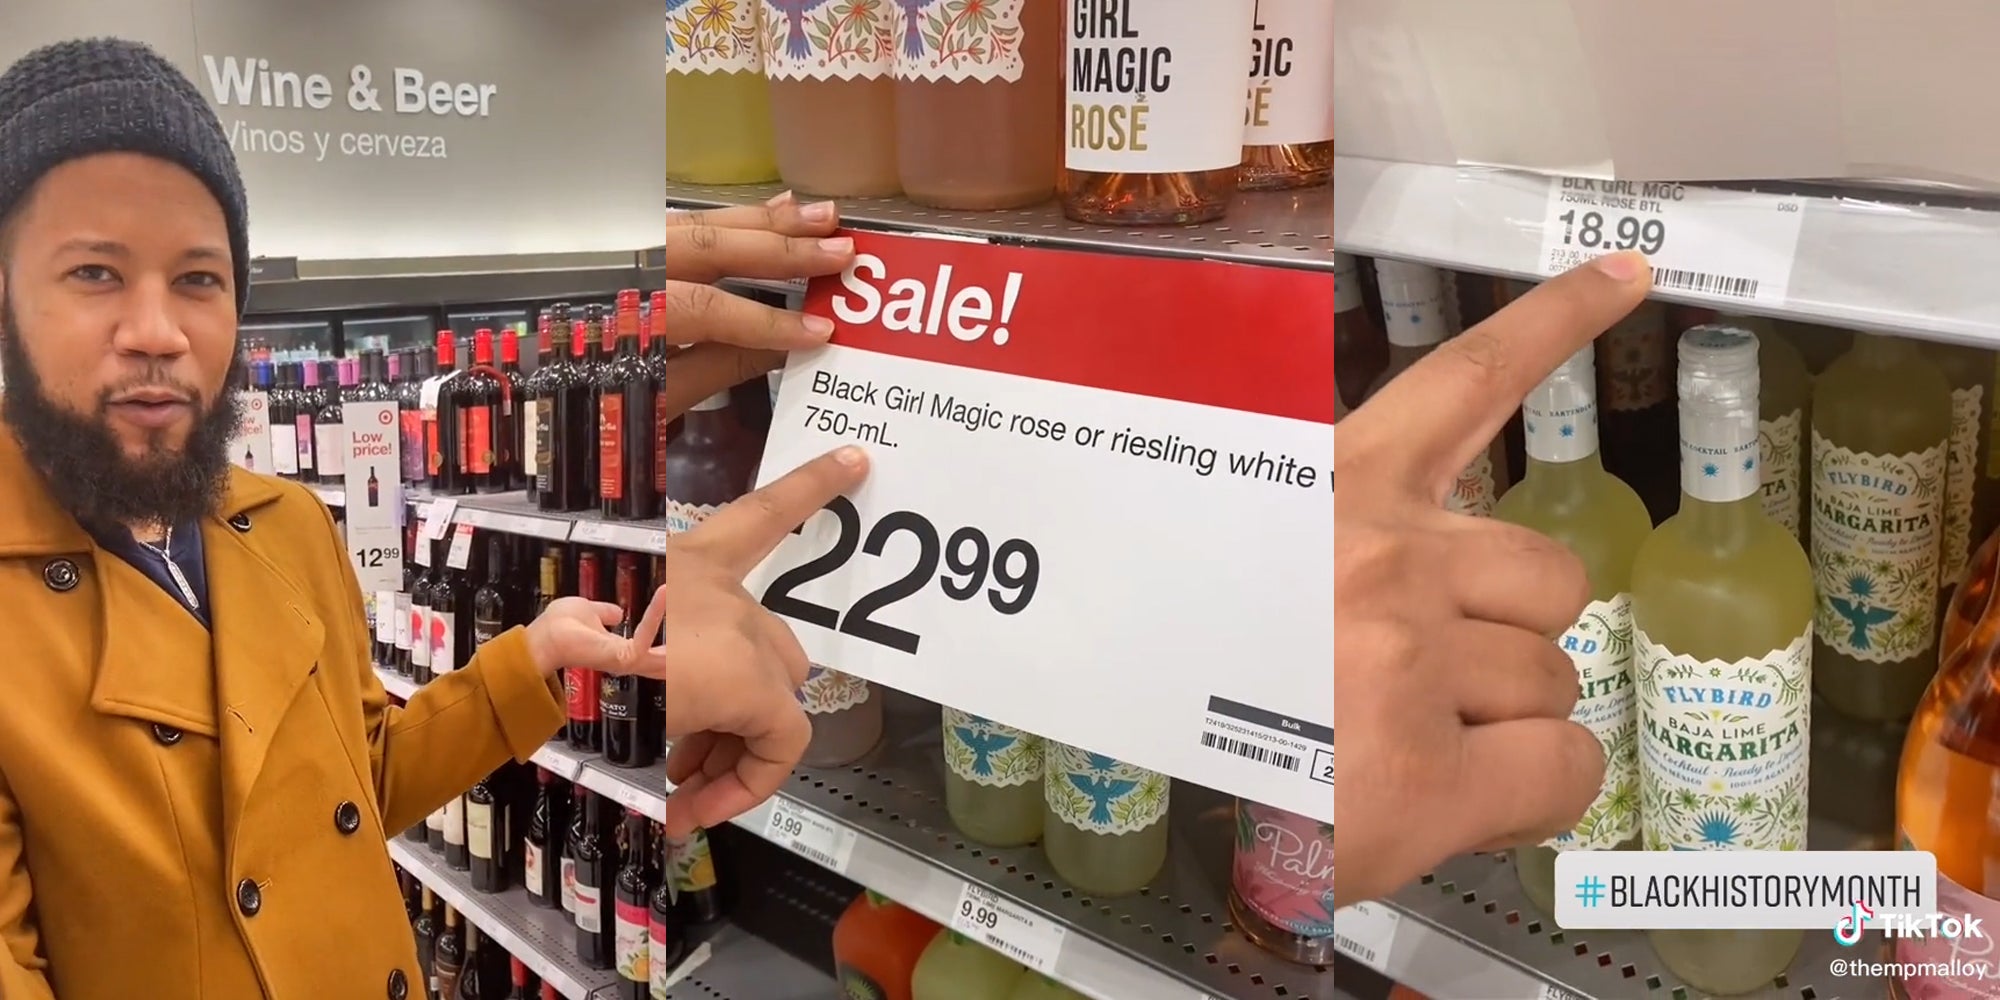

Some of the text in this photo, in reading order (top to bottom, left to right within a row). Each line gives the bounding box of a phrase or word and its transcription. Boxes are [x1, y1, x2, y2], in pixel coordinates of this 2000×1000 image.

[1074, 0, 1139, 38] GIRL
[1073, 46, 1171, 93] MAGIC
[1249, 37, 1293, 78] GIC
[203, 54, 497, 116] Wine & Beer
[222, 119, 447, 162] Vinos y cerveza
[1071, 93, 1150, 152] ROSÉ
[1562, 178, 1685, 201] BLK GRL MGC
[1639, 200, 1664, 213] BTL
[1559, 209, 1666, 256] 18.99
[831, 253, 1024, 346] Sale!
[352, 431, 383, 444] Low
[803, 406, 899, 449] 750-mL.
[811, 370, 878, 406] Black
[884, 385, 925, 416] Girl
[930, 393, 1003, 432] Magic
[1009, 413, 1067, 441] rose
[1075, 423, 1104, 448] or
[1111, 430, 1218, 477] riesling
[1228, 449, 1317, 489] white
[353, 442, 392, 458] price!
[1827, 471, 1908, 497] FLYBIRD
[1814, 492, 1931, 534] MARGARITA
[1867, 506, 1902, 517] LIME
[1663, 685, 1773, 709] FLYBIRD
[1281, 719, 1302, 732] Bulk
[1642, 711, 1799, 762] MARGARITA
[1668, 716, 1766, 740] BAJA LIME
[771, 811, 803, 837] 9.99
[960, 899, 998, 929] 9.99
